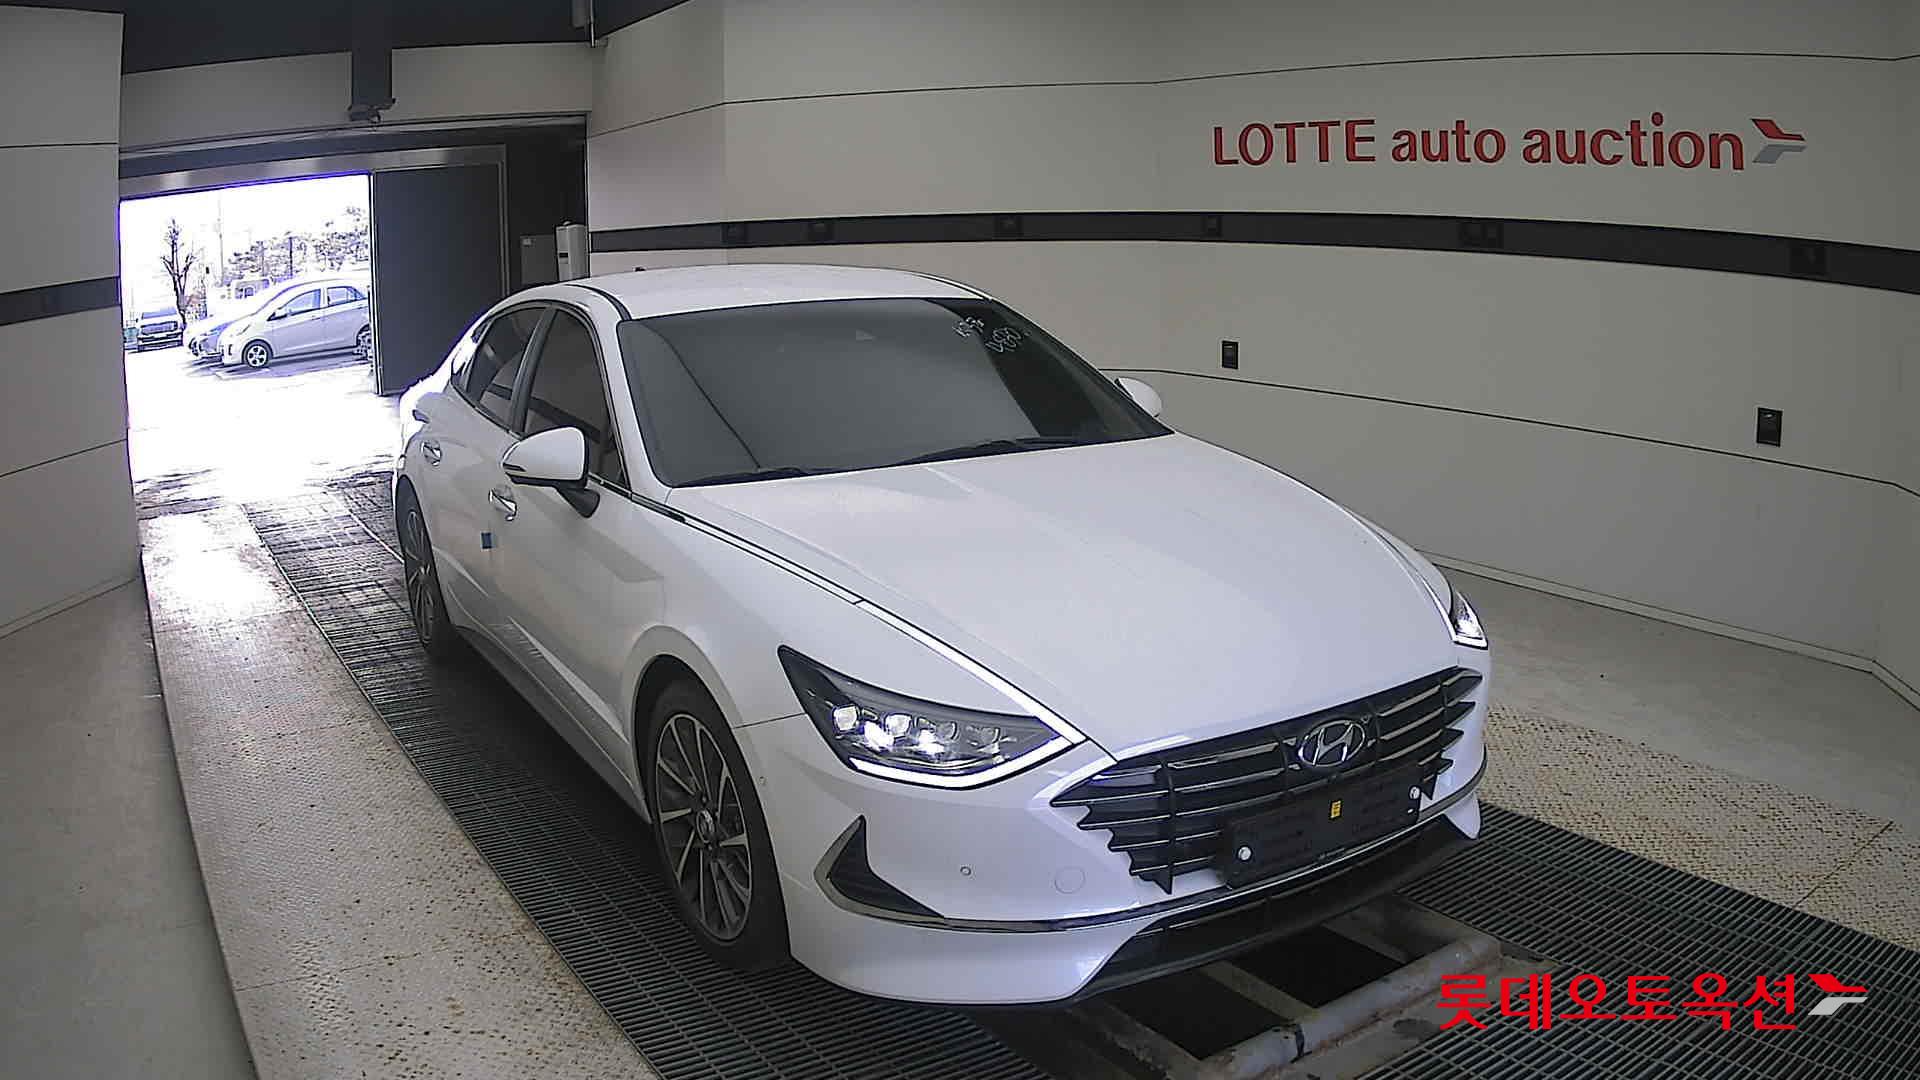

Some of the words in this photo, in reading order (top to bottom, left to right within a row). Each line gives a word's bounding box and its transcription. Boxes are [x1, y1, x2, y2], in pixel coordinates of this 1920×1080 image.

[1213, 119, 1376, 166] LOTTE
[1391, 119, 1506, 163] auto
[1522, 111, 1745, 170] auction
